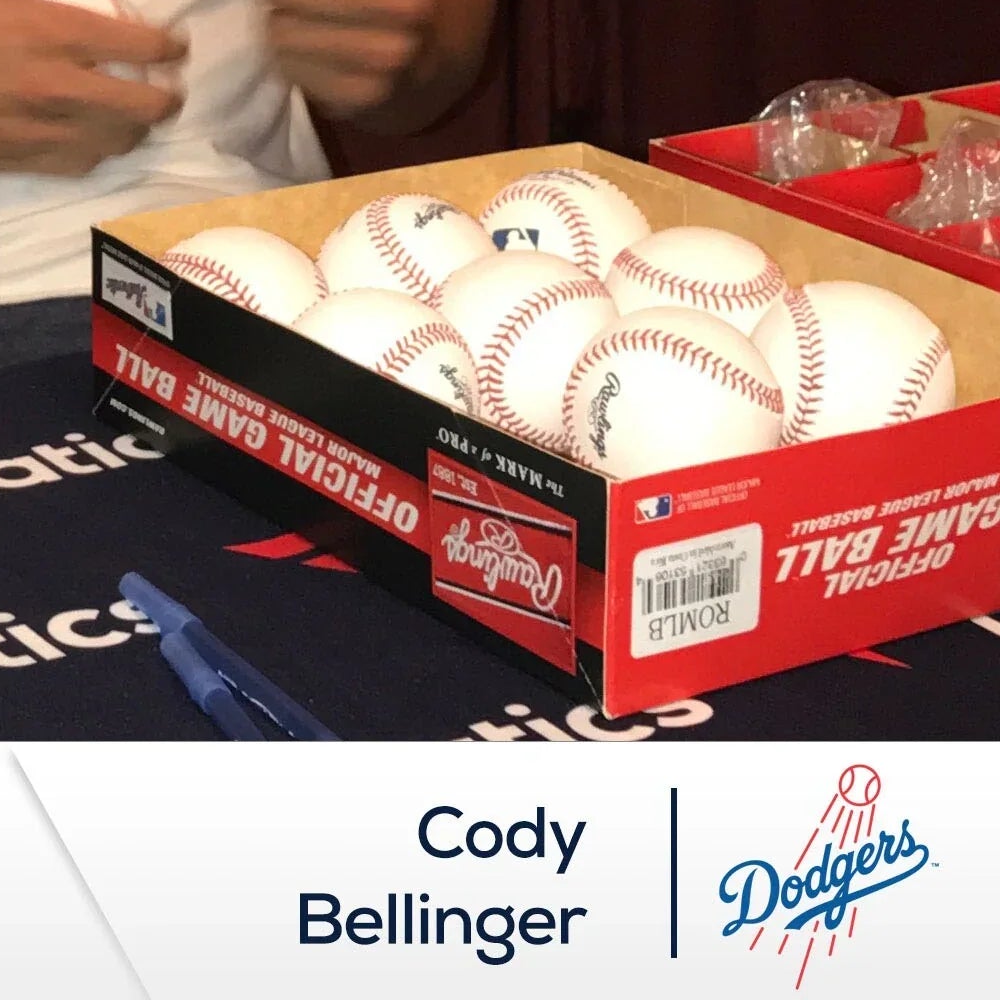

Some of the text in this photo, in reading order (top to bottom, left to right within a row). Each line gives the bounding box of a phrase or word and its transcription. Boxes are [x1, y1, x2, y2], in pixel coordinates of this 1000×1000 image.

[115, 343, 419, 533] OFFICIAL GAME BALL
[198, 371, 382, 479] MAJOR LEAGUE BASEBALL
[438, 427, 564, 498] The MARK of a PRO
[775, 494, 1000, 583] GAME BALL
[791, 472, 1000, 538] MAJOR LEAGUE BASEBALL
[441, 518, 562, 612] Rawlings
[823, 543, 955, 599] OFFICIAL
[649, 600, 731, 641] ROMLB
